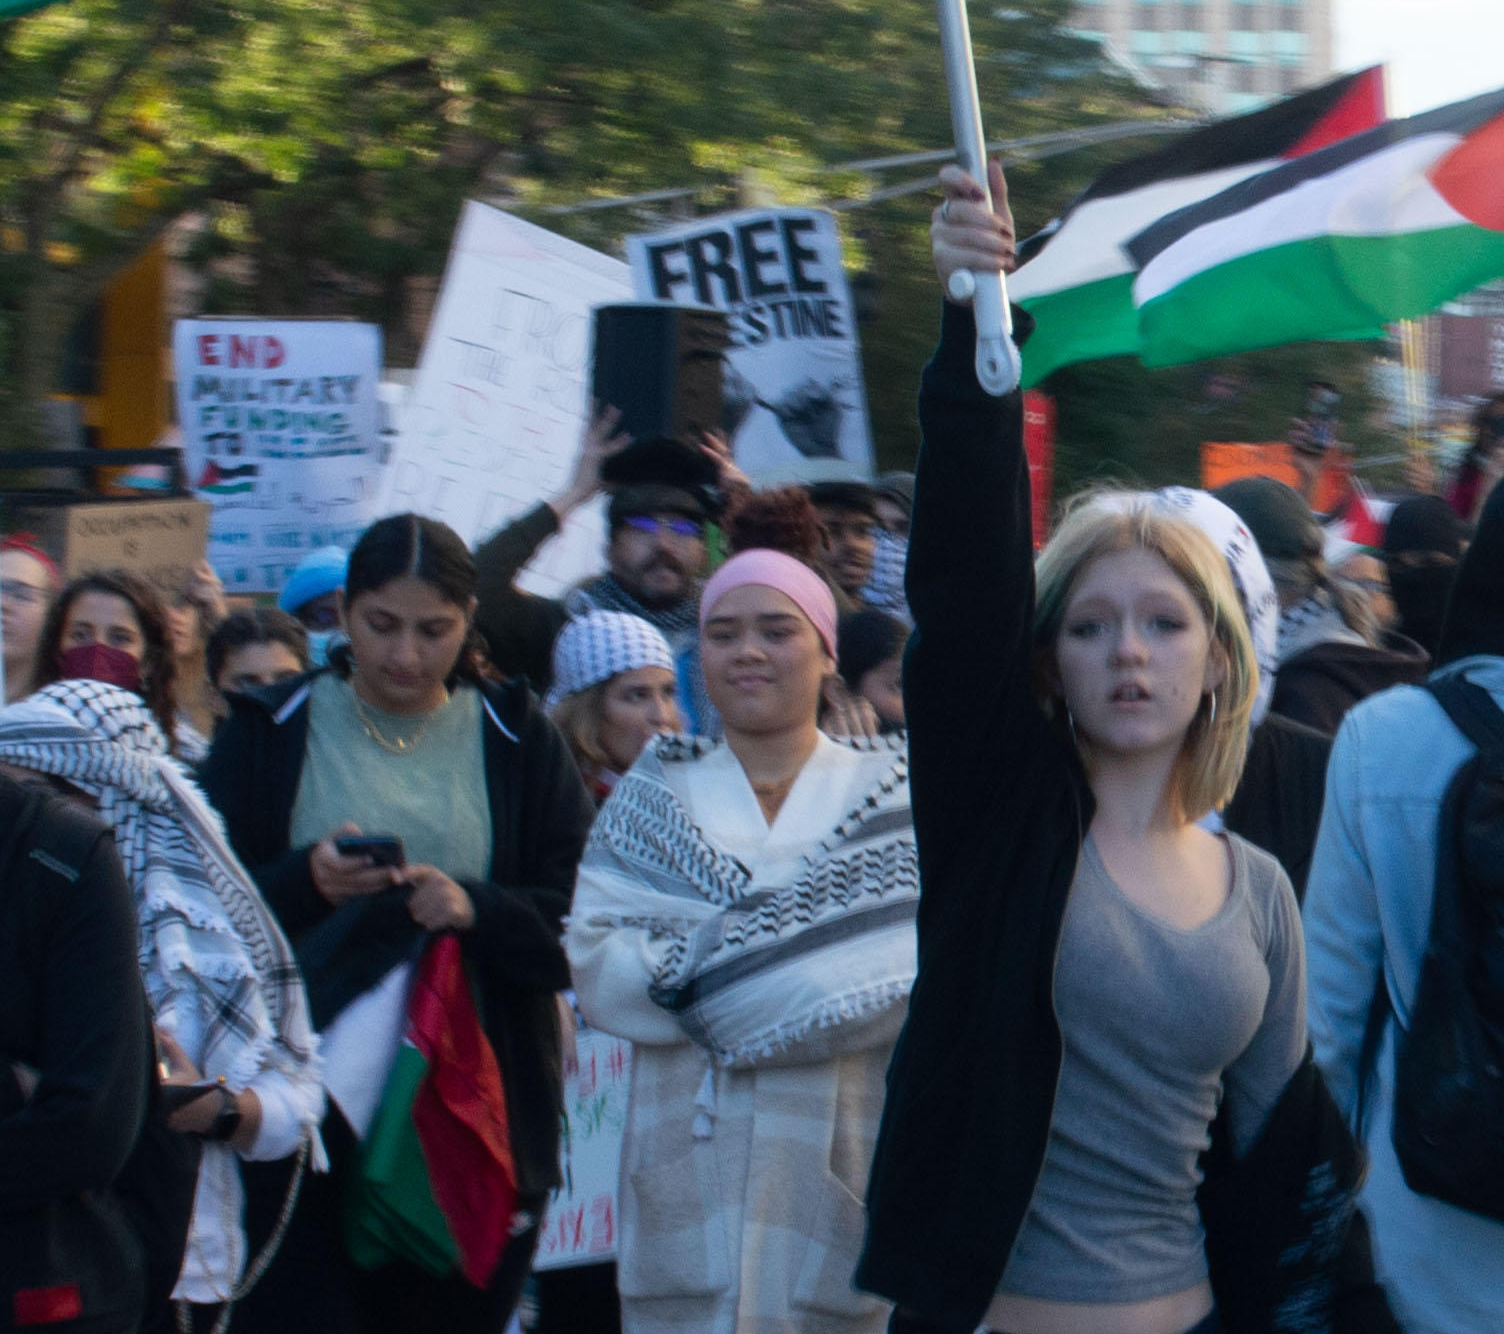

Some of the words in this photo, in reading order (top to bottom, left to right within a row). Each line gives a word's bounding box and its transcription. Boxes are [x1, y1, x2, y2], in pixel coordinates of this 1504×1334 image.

[648, 218, 829, 307] FREE
[197, 334, 287, 369] END
[192, 375, 361, 405] MILITARY
[200, 405, 351, 434] FUNDING
